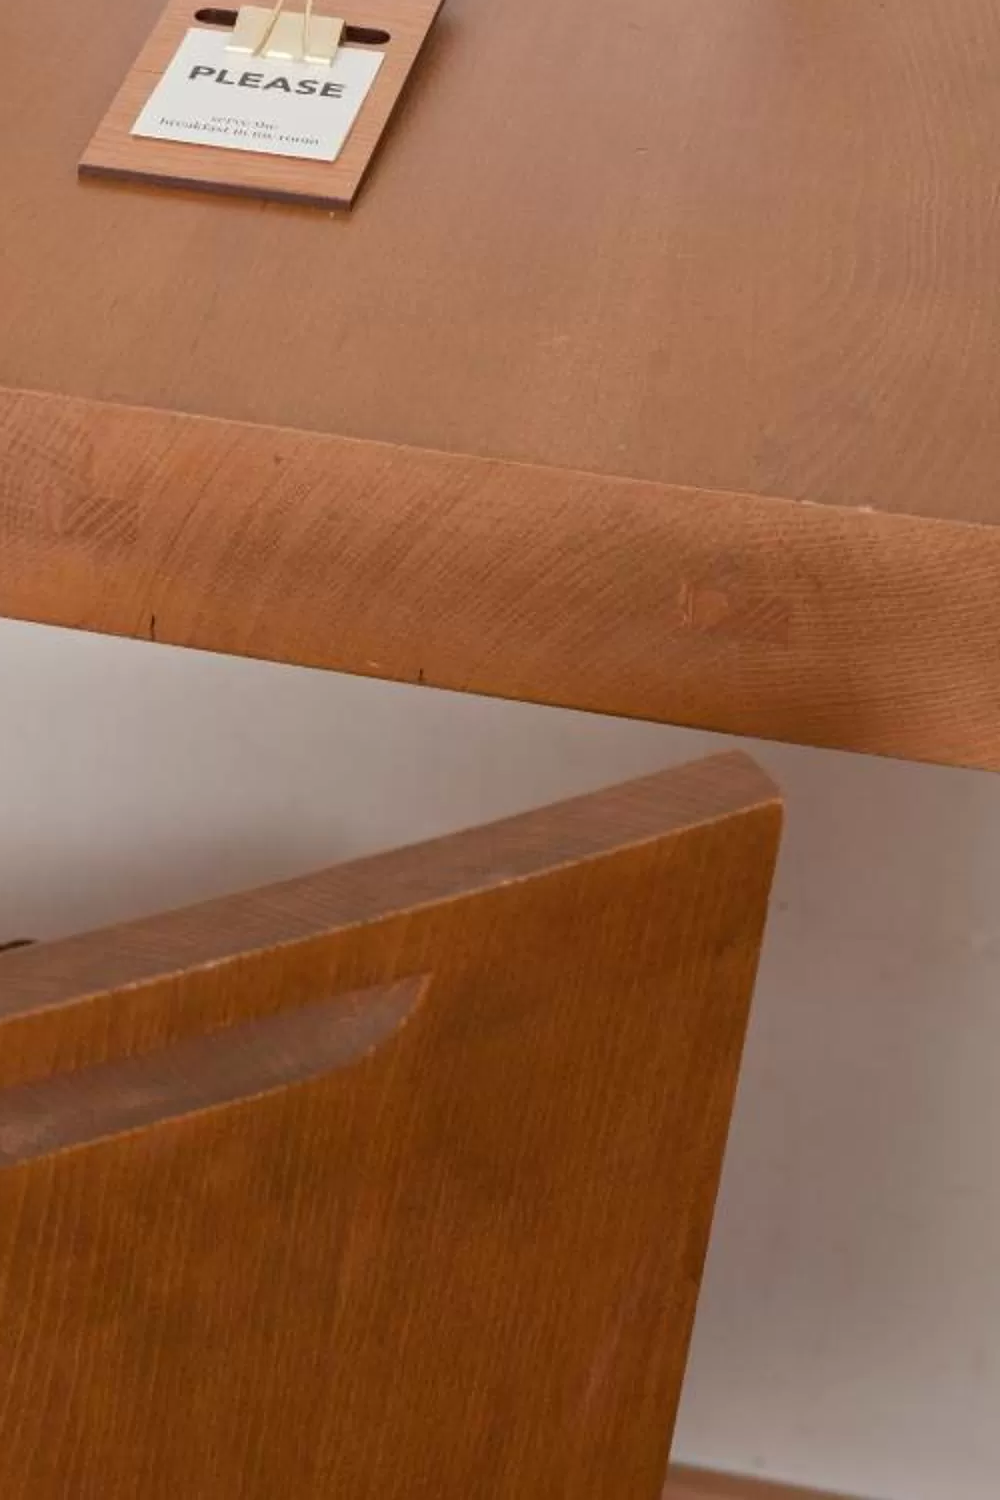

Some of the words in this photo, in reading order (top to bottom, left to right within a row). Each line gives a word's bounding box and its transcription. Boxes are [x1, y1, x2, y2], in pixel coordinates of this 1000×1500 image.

[188, 65, 345, 99] PLEASE
[159, 117, 229, 134] breakfast
[278, 135, 320, 146] room
